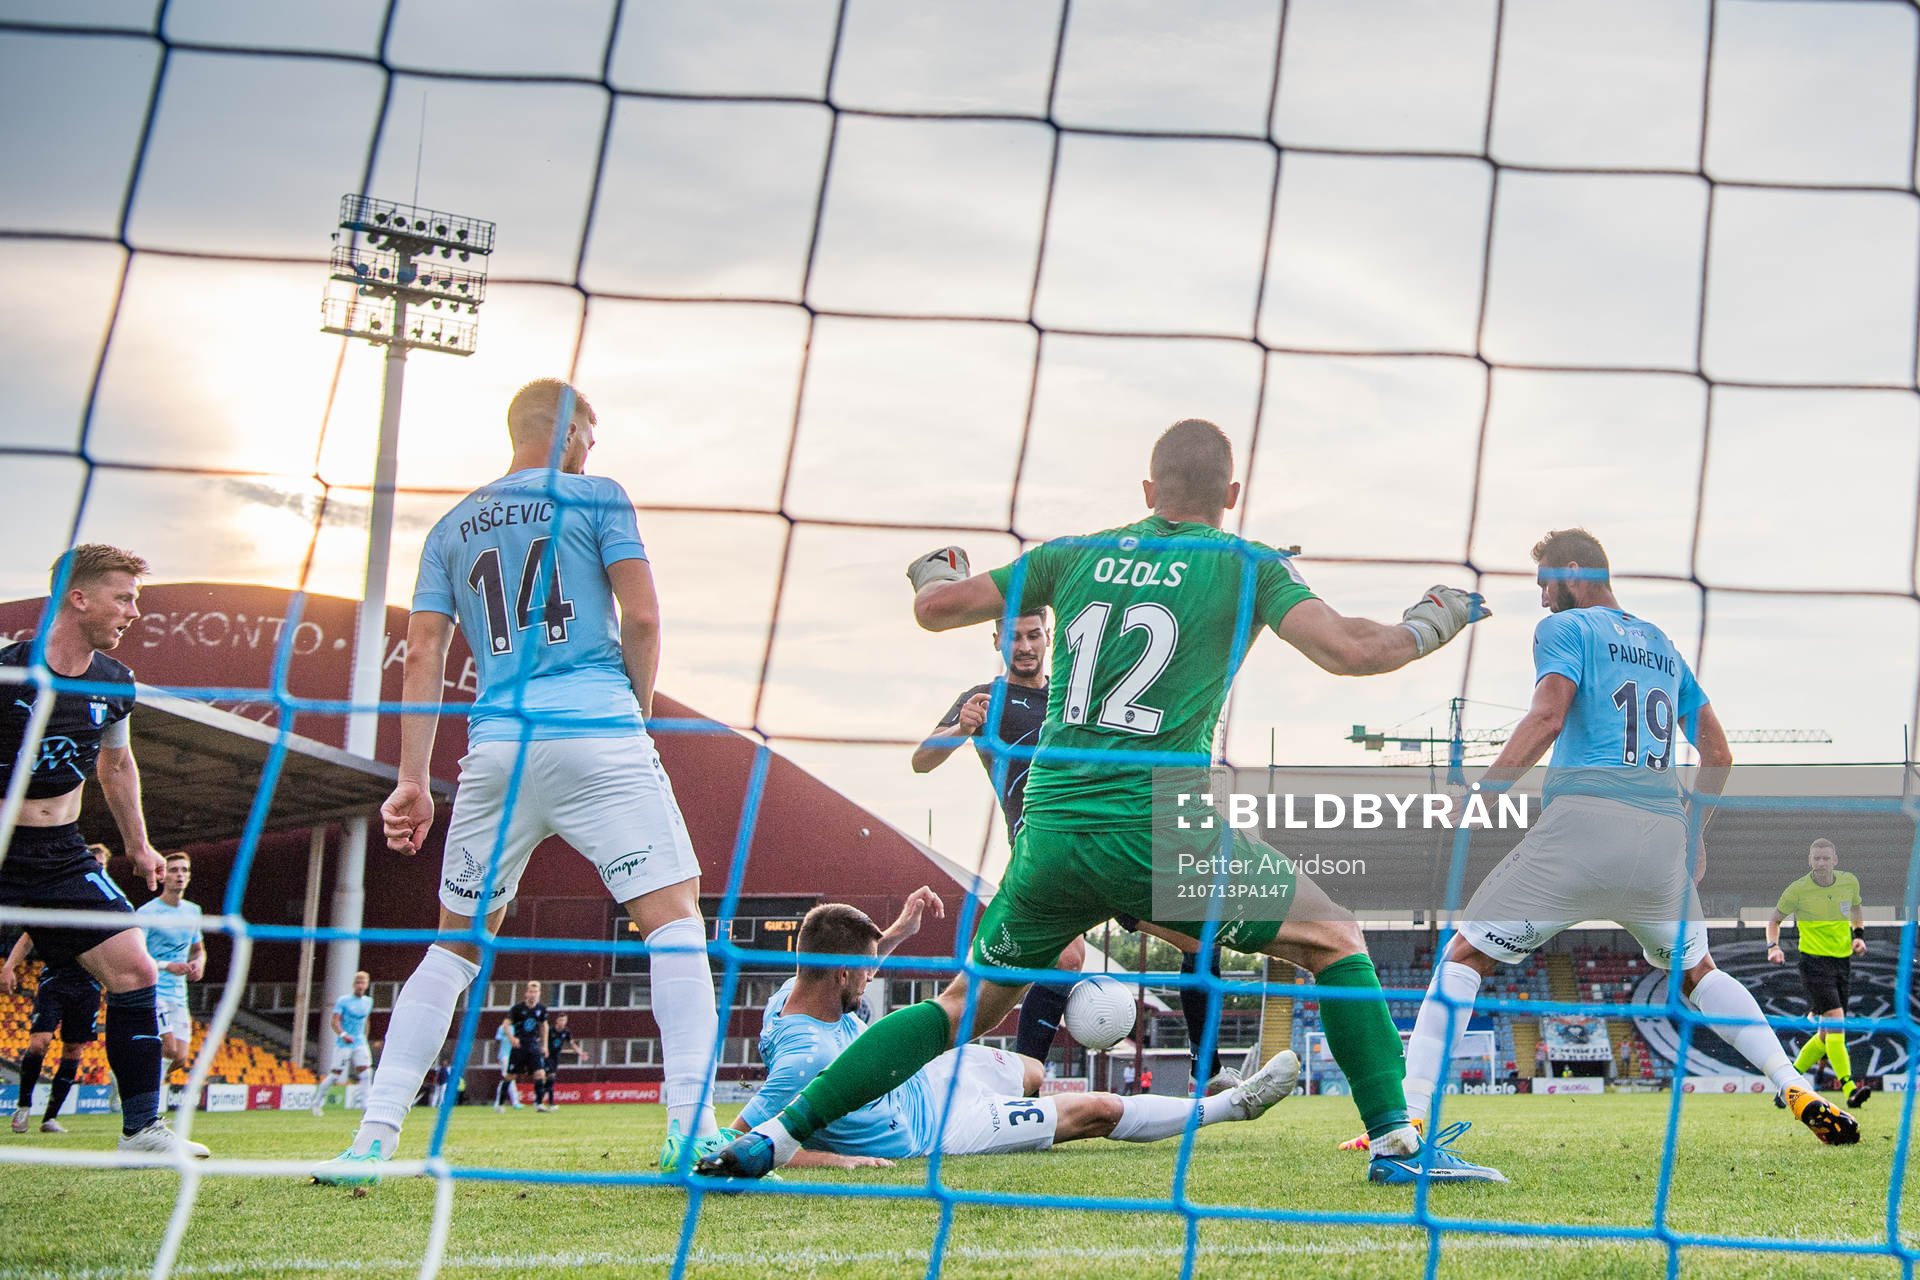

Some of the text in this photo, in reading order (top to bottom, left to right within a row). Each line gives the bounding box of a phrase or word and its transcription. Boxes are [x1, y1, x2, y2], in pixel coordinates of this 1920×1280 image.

[1094, 557, 1188, 587] OZOLS
[468, 535, 576, 656] 14
[142, 611, 324, 656] SKONTO
[1063, 601, 1179, 736] 12
[1611, 680, 1674, 774] 19
[764, 921, 798, 931] GUEST
[1463, 1082, 1517, 1095] betsafe
